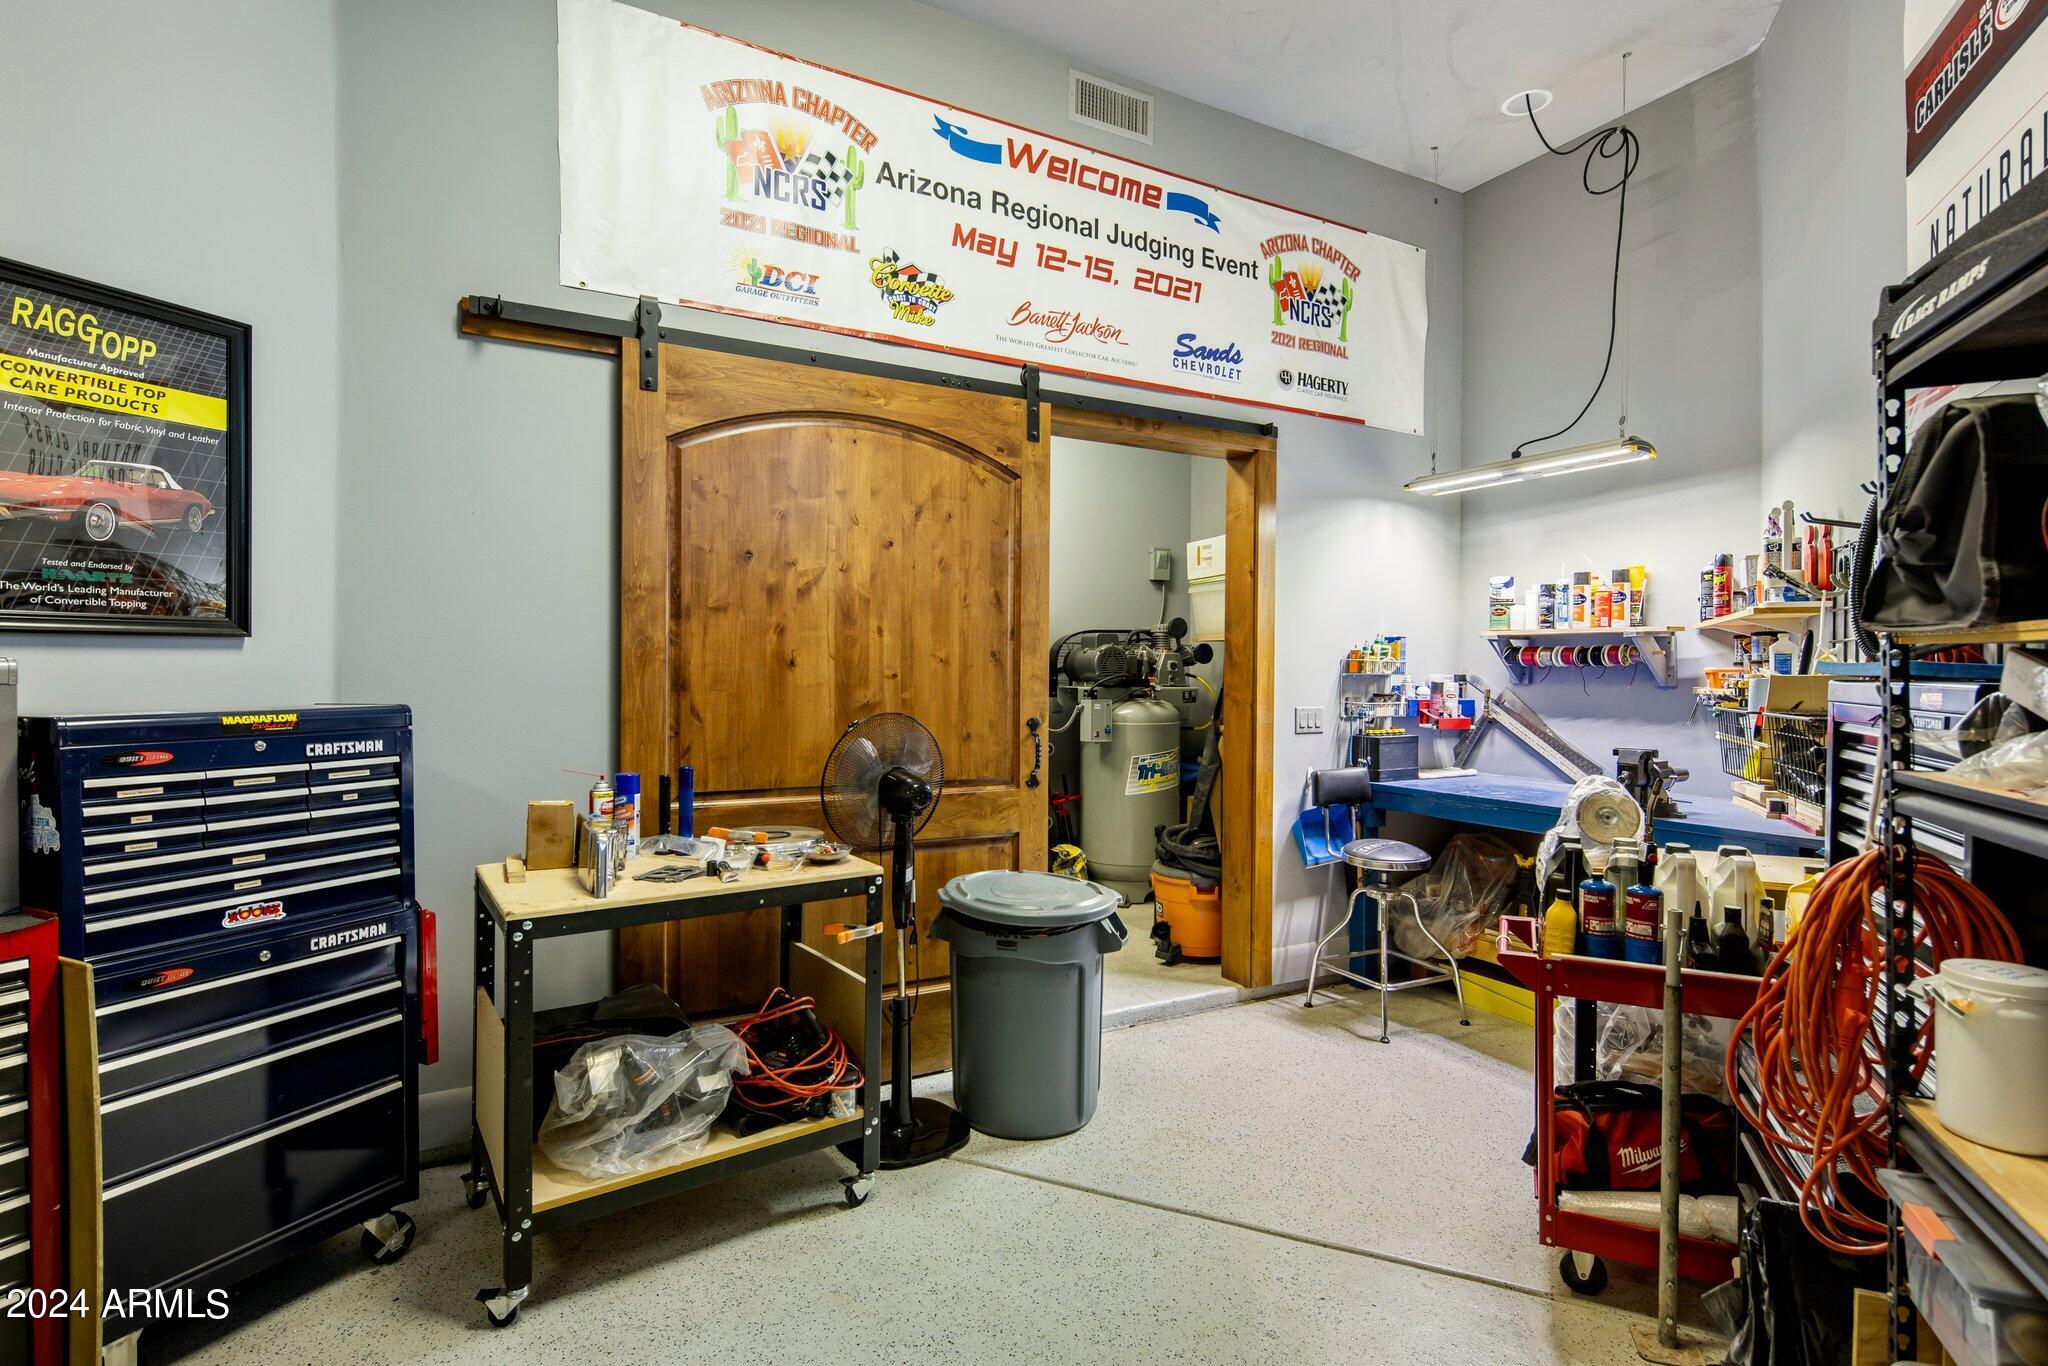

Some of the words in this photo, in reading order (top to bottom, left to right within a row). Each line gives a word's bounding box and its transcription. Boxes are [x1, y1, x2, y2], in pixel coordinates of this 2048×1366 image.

[1916, 9, 1993, 132] CARLISLE
[700, 78, 788, 111] ARIZONA
[791, 85, 879, 155] CHAPTER
[754, 164, 827, 212] NCRS
[1005, 137, 1164, 210] Welcome
[720, 206, 767, 235] 2021
[770, 218, 861, 254] REGIONAL
[875, 160, 983, 211] Arizona
[991, 189, 1100, 241] Regional
[1106, 223, 1195, 271] Judging
[1202, 247, 1259, 280] Event
[951, 222, 1019, 268] May
[1035, 243, 1119, 287] 12-15,
[1134, 268, 1202, 304] 2021
[1259, 233, 1309, 261] ARIZONA
[1311, 237, 1361, 283] CHAPTER
[759, 263, 820, 295] DCI
[869, 256, 954, 303] Corvette
[1936, 256, 1991, 309] RAMPS
[735, 285, 768, 298] GARAGE
[769, 291, 820, 308] OUTFITTERS
[889, 294, 907, 303] COAST
[919, 299, 937, 313] COAST
[890, 301, 936, 327] Mike
[1006, 300, 1129, 346] Barrett-Jackson
[1289, 298, 1332, 328] NCRS
[1173, 333, 1243, 364] Sands
[1271, 330, 1296, 348] 2021
[1298, 336, 1349, 360] REGIONAL
[27, 347, 98, 369] Manufacturer
[100, 363, 145, 379] Approved
[1173, 357, 1241, 380] CHEVROLET
[0, 360, 128, 394] CONVERTIBLE
[133, 385, 166, 400] TOP
[9, 376, 58, 396] CARE
[64, 387, 159, 414] PRODUCTS
[1298, 372, 1348, 395] HAGERTY
[3, 400, 43, 415] Interior
[46, 408, 95, 424] Protection
[98, 417, 112, 428] for
[168, 428, 185, 439] and
[187, 432, 220, 446] Leather
[42, 558, 69, 568] Tested
[70, 561, 86, 569] and
[88, 561, 123, 571] Endorsed
[125, 563, 134, 572] by
[0, 581, 20, 590] The
[22, 581, 64, 593] World's
[68, 585, 107, 597] Leading
[110, 587, 174, 598] Manufacturer
[30, 596, 42, 604] of
[45, 595, 107, 607] Convertible
[109, 598, 147, 610] Topping
[222, 714, 297, 725] MAGNAFLOW
[306, 739, 384, 757] CRAFTSMAN
[310, 923, 387, 951] CRAFTSMAN
[141, 975, 166, 987] QUIET
[1617, 1139, 1687, 1168] Milwae
